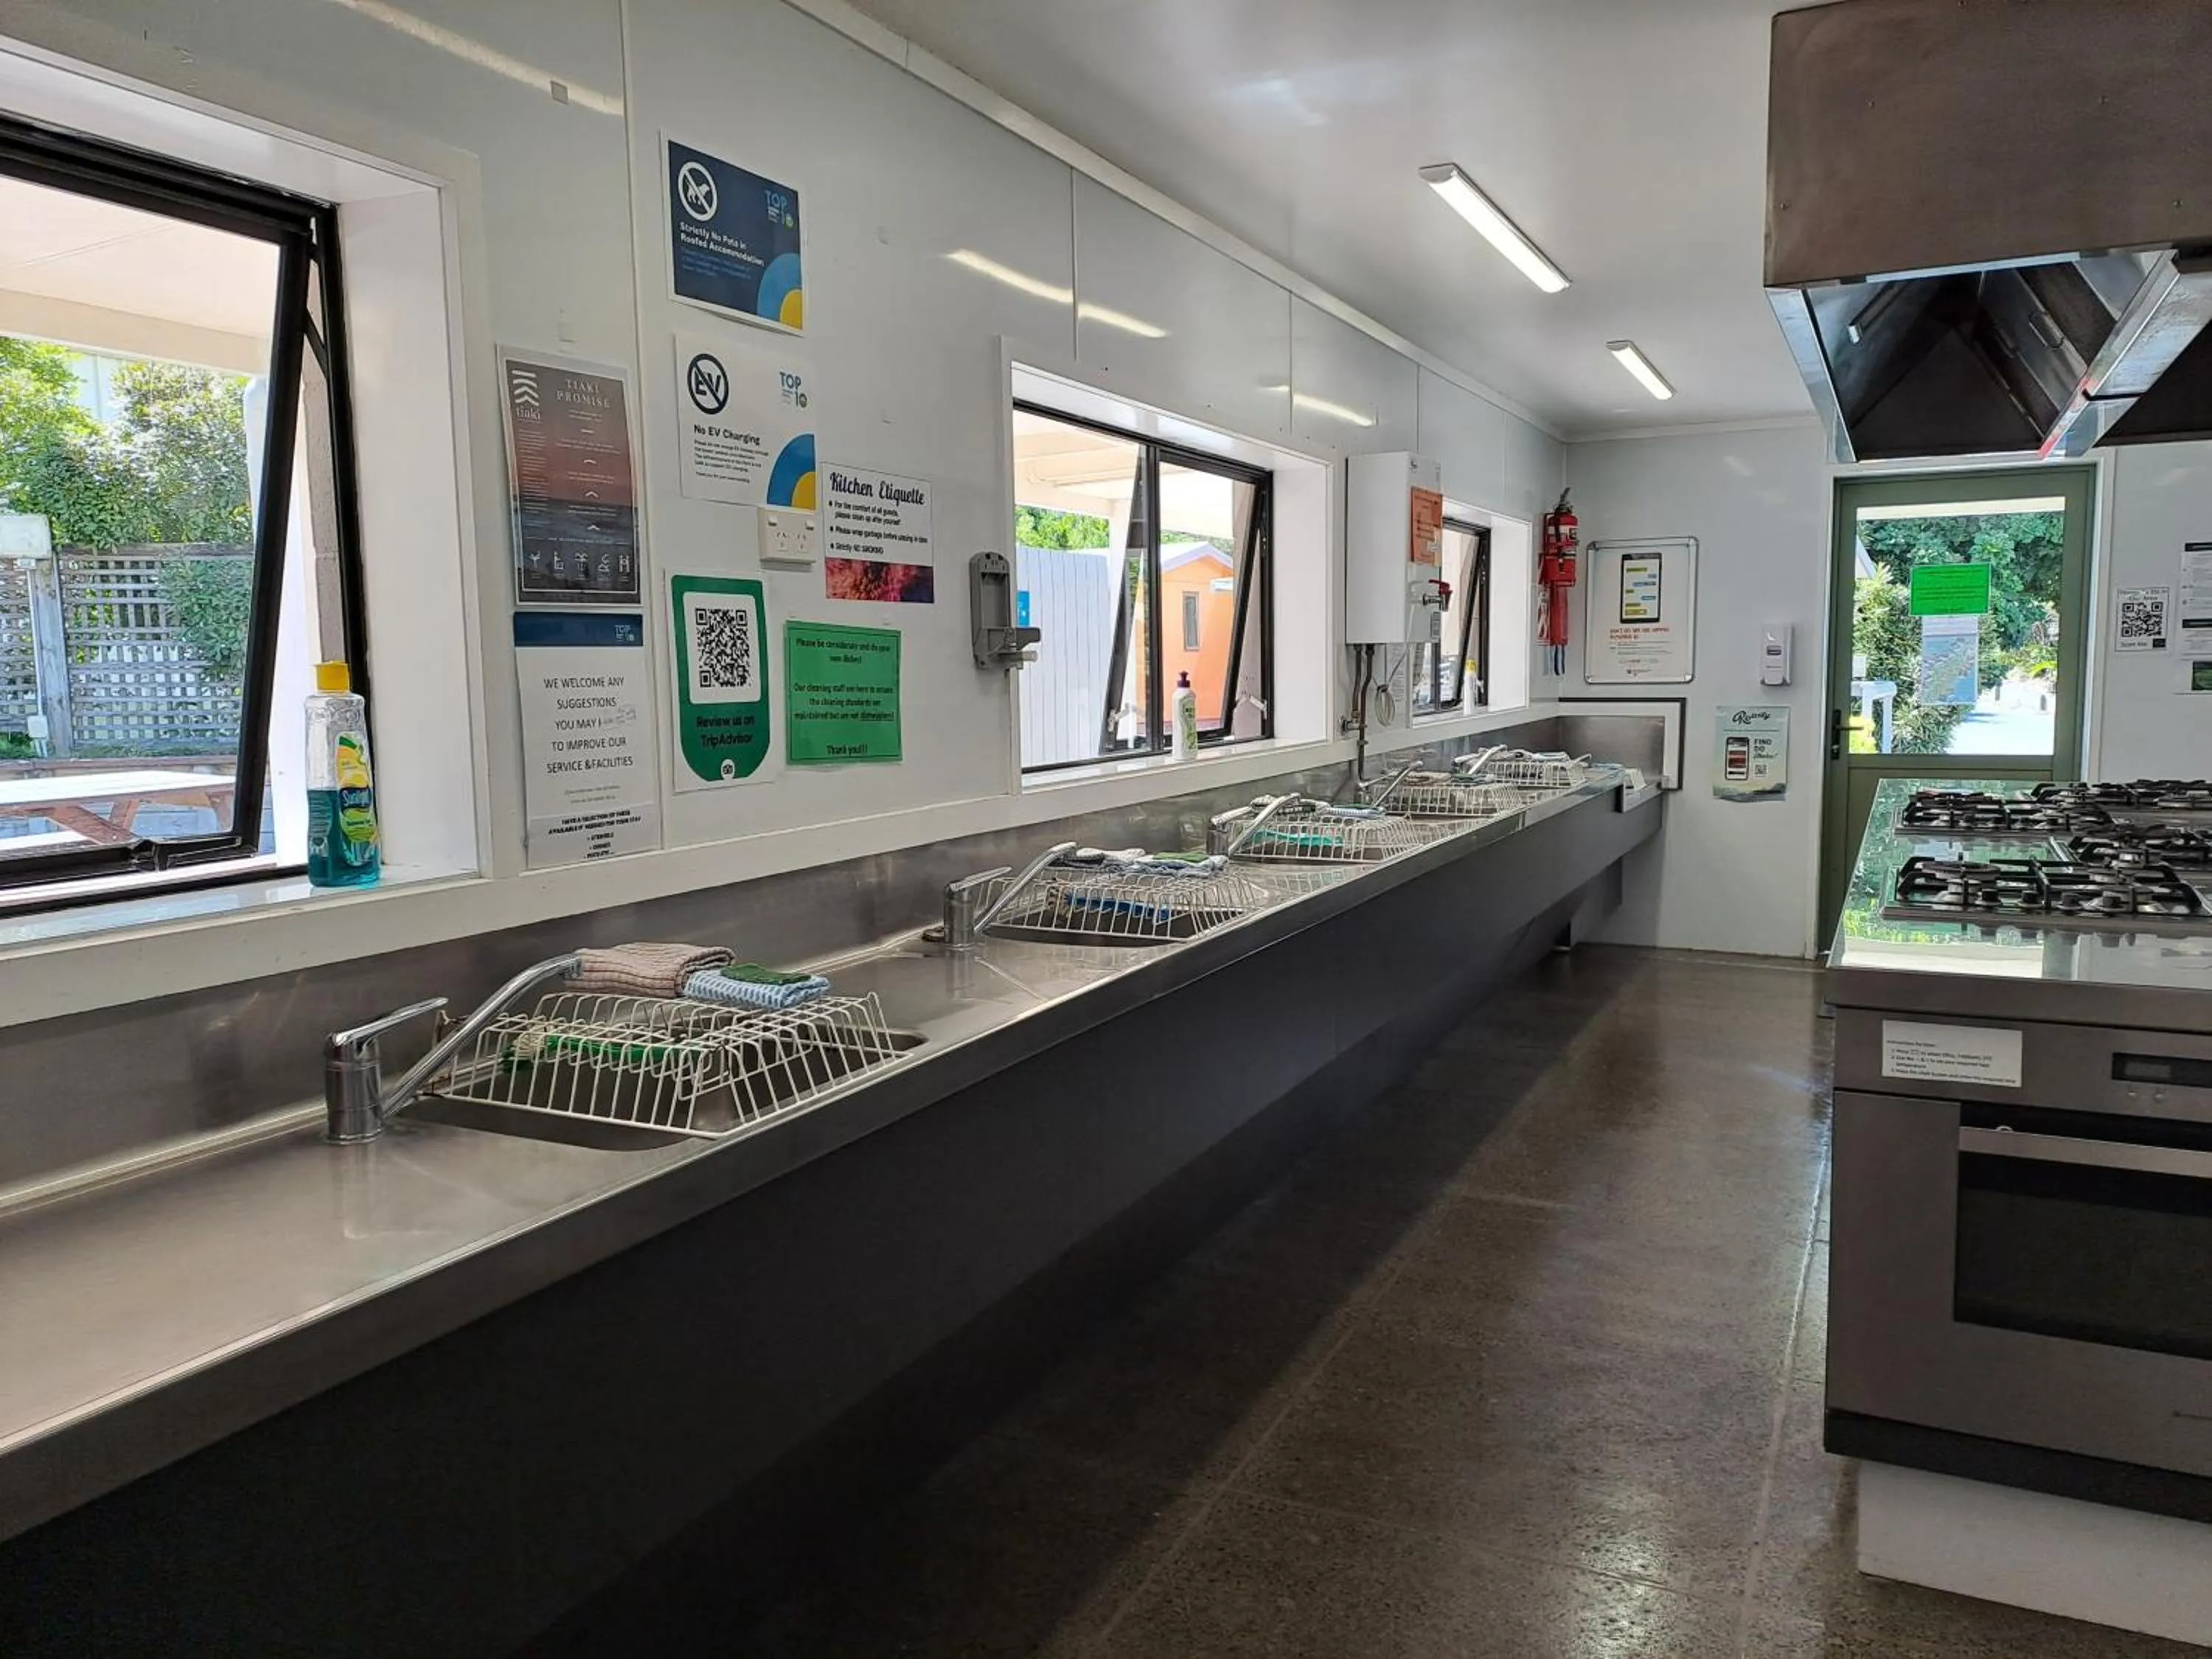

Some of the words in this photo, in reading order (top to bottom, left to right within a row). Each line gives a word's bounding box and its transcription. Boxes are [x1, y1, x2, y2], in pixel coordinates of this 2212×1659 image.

[764, 190, 787, 210] TOP
[680, 221, 709, 240] Strictly
[711, 232, 721, 241] No
[681, 232, 708, 248] Roofed
[709, 241, 765, 266] Accommodation
[779, 372, 801, 389] TOP
[557, 390, 611, 408] PROMISE
[794, 392, 807, 408] 10
[694, 424, 706, 435] No
[708, 426, 720, 437] EV
[723, 429, 760, 445] Charging
[830, 471, 873, 497] Kitchen
[879, 480, 925, 507] Etiquette
[796, 638, 815, 647] Please
[543, 678, 559, 689] WE
[560, 677, 605, 688] WELCOME
[608, 676, 625, 687] ANY
[807, 684, 831, 693] cleaning
[557, 697, 616, 709] SUGGESTIONS
[555, 720, 574, 730] YOU
[576, 718, 597, 729] MAY
[697, 716, 730, 728] Review
[732, 717, 742, 726] us
[744, 716, 754, 725] on
[552, 741, 564, 751] TO
[566, 738, 606, 750] IMPROVE
[608, 737, 626, 747] OUR
[701, 733, 753, 750] TripAdvisor
[826, 744, 846, 755] Thank
[546, 760, 582, 773] SERVICE
